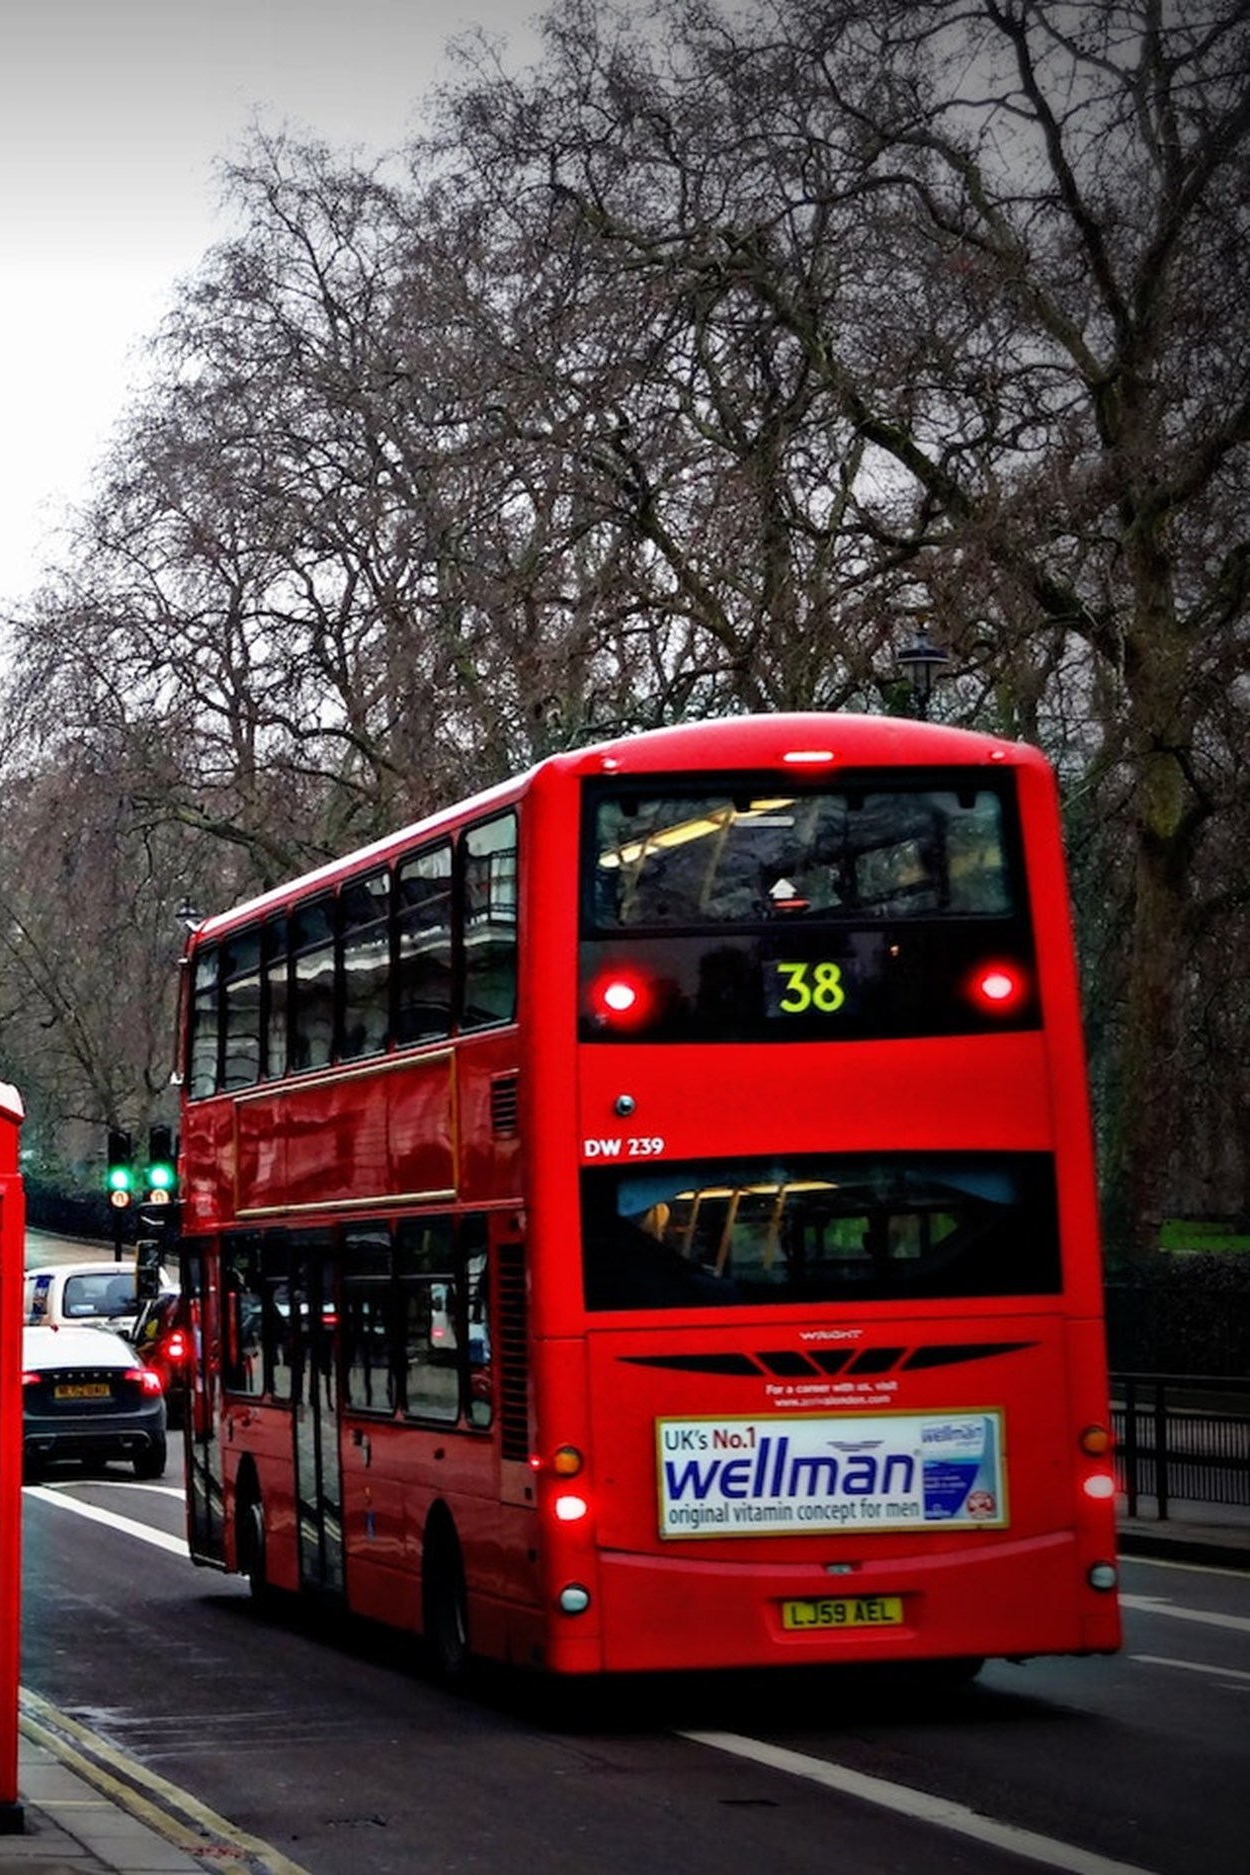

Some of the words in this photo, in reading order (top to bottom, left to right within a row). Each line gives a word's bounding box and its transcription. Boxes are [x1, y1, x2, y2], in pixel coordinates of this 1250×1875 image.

[777, 962, 845, 1013] 38
[584, 1139, 621, 1157] DW
[627, 1137, 664, 1156] 239
[799, 1329, 863, 1340] WRIGHT
[766, 1384, 784, 1395] For
[785, 1386, 793, 1394] a
[795, 1384, 830, 1394] career
[665, 1428, 708, 1450] UK's
[713, 1427, 756, 1449] No.1
[665, 1436, 915, 1500] wellman
[669, 1502, 729, 1529] original
[732, 1501, 793, 1523] vitamin
[797, 1502, 857, 1524] concept
[860, 1498, 881, 1519] for
[886, 1500, 919, 1518] men
[791, 1602, 846, 1625] LJ59
[854, 1601, 893, 1622] AEL
